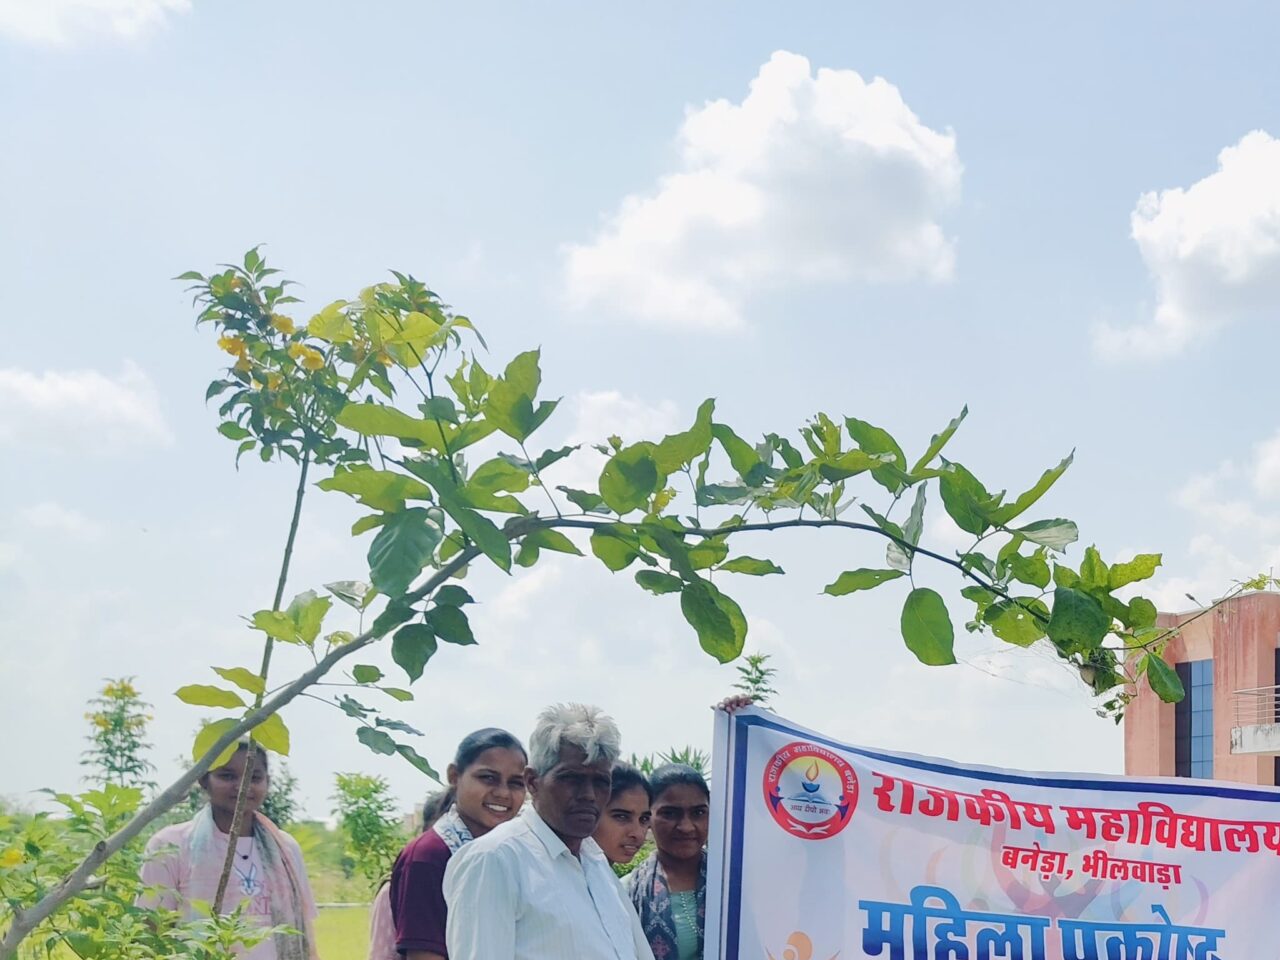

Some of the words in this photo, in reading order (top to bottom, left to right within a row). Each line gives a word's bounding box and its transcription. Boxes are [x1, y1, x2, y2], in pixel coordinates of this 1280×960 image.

[872, 771, 1055, 834] राजकीय
[1002, 842, 1074, 880] बनेड़ा,
[1082, 850, 1182, 890] भीलवाड़ा
